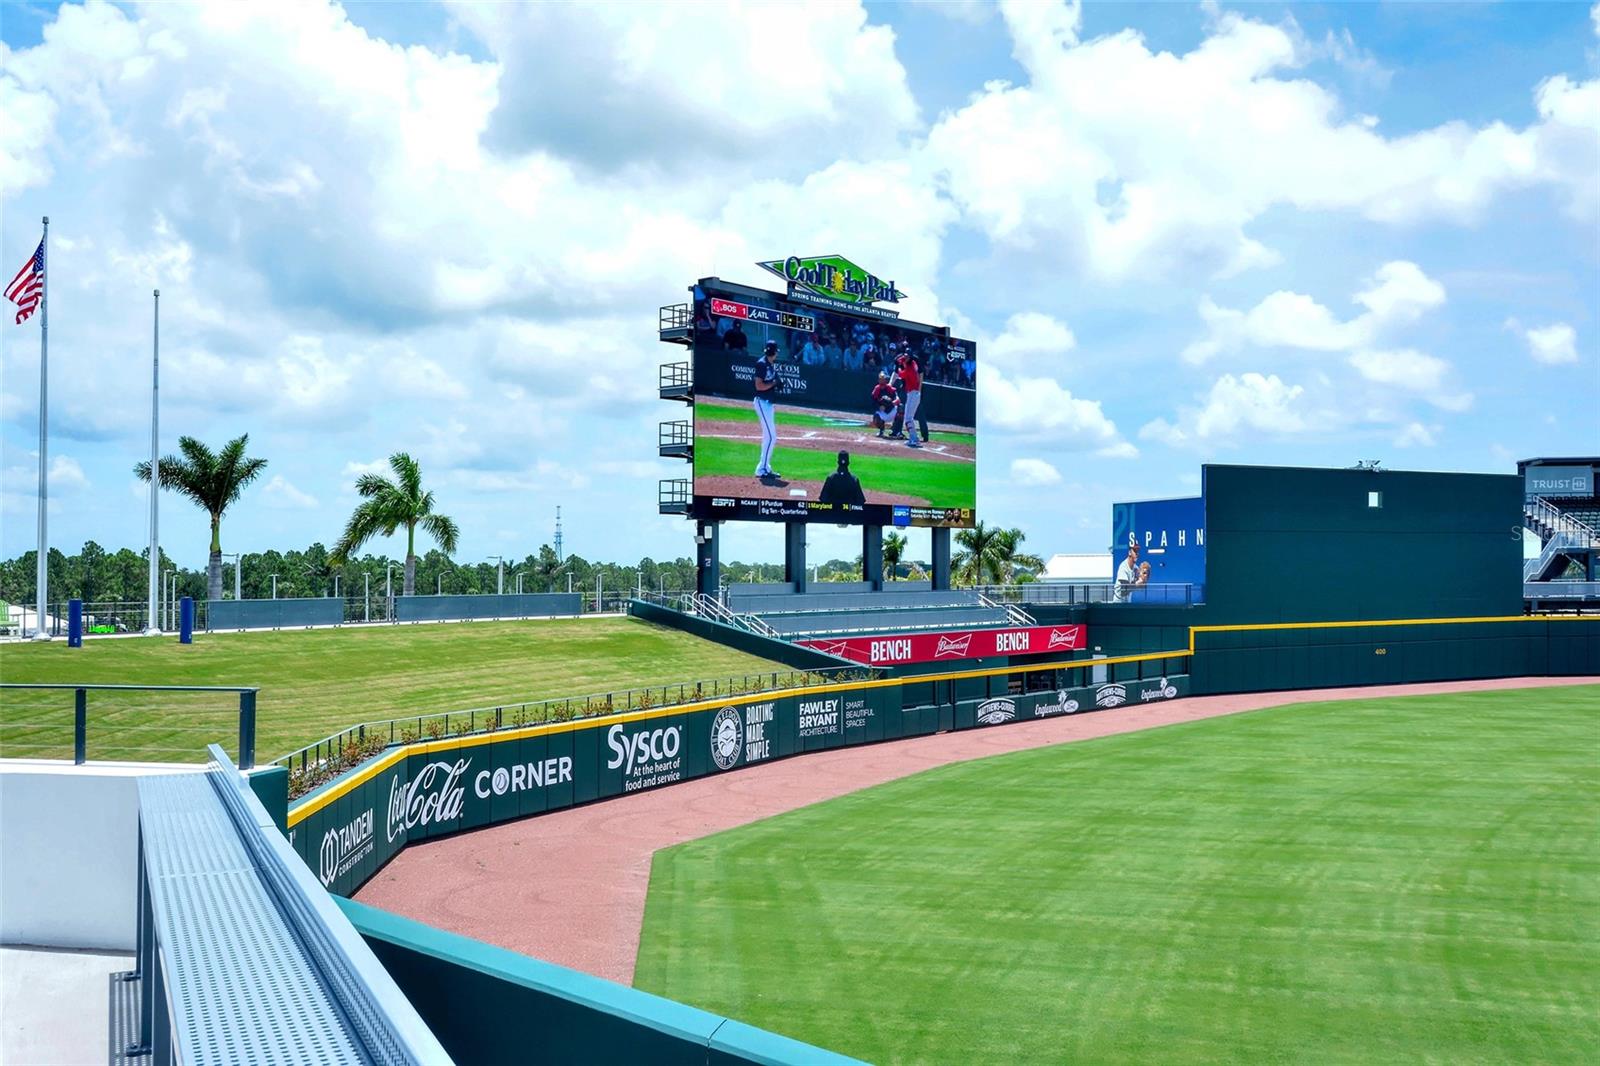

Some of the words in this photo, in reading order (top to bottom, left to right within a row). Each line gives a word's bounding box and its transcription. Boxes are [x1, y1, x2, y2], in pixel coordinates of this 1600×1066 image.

[865, 274, 899, 303] Park
[722, 304, 737, 313] BOS
[742, 307, 746, 316] 1
[791, 291, 809, 300] SPRING
[810, 296, 832, 306] TRAINING
[833, 301, 847, 309] HOME
[862, 307, 880, 316] ATLANTA
[881, 311, 897, 319] BRAVES
[757, 311, 769, 320] ATL
[731, 364, 756, 374] COMING
[735, 373, 752, 381] SOON
[1532, 480, 1570, 488] TRUIST
[712, 498, 735, 507] ESPN
[811, 502, 833, 510] Maryland
[780, 508, 808, 516] Quarterfinals
[996, 632, 1029, 652] BENCH
[1051, 633, 1076, 642] Budweiser
[871, 640, 911, 661] BENCH
[939, 640, 968, 651] Budweiser
[799, 700, 838, 715] FAWLEY
[845, 700, 864, 709] SMART
[1035, 703, 1062, 717] Englewood
[716, 710, 739, 730] FREEDOM
[746, 703, 773, 724] BOATING
[799, 713, 838, 728] BRYANT
[845, 709, 874, 718] BEAUTIFUL
[845, 718, 865, 728] SPACES
[746, 723, 764, 743] MADE
[799, 725, 837, 737] ARCHITECTURE
[746, 740, 770, 762] SIMPLE
[633, 767, 641, 777] At
[642, 764, 653, 774] the
[655, 759, 672, 773] heart
[673, 758, 680, 768] of
[475, 756, 573, 799] CORNER
[626, 779, 641, 791] food
[643, 775, 656, 787] and
[657, 771, 680, 784] service
[339, 808, 373, 856] TANDEM
[338, 842, 373, 876] CONSTRUCTION
